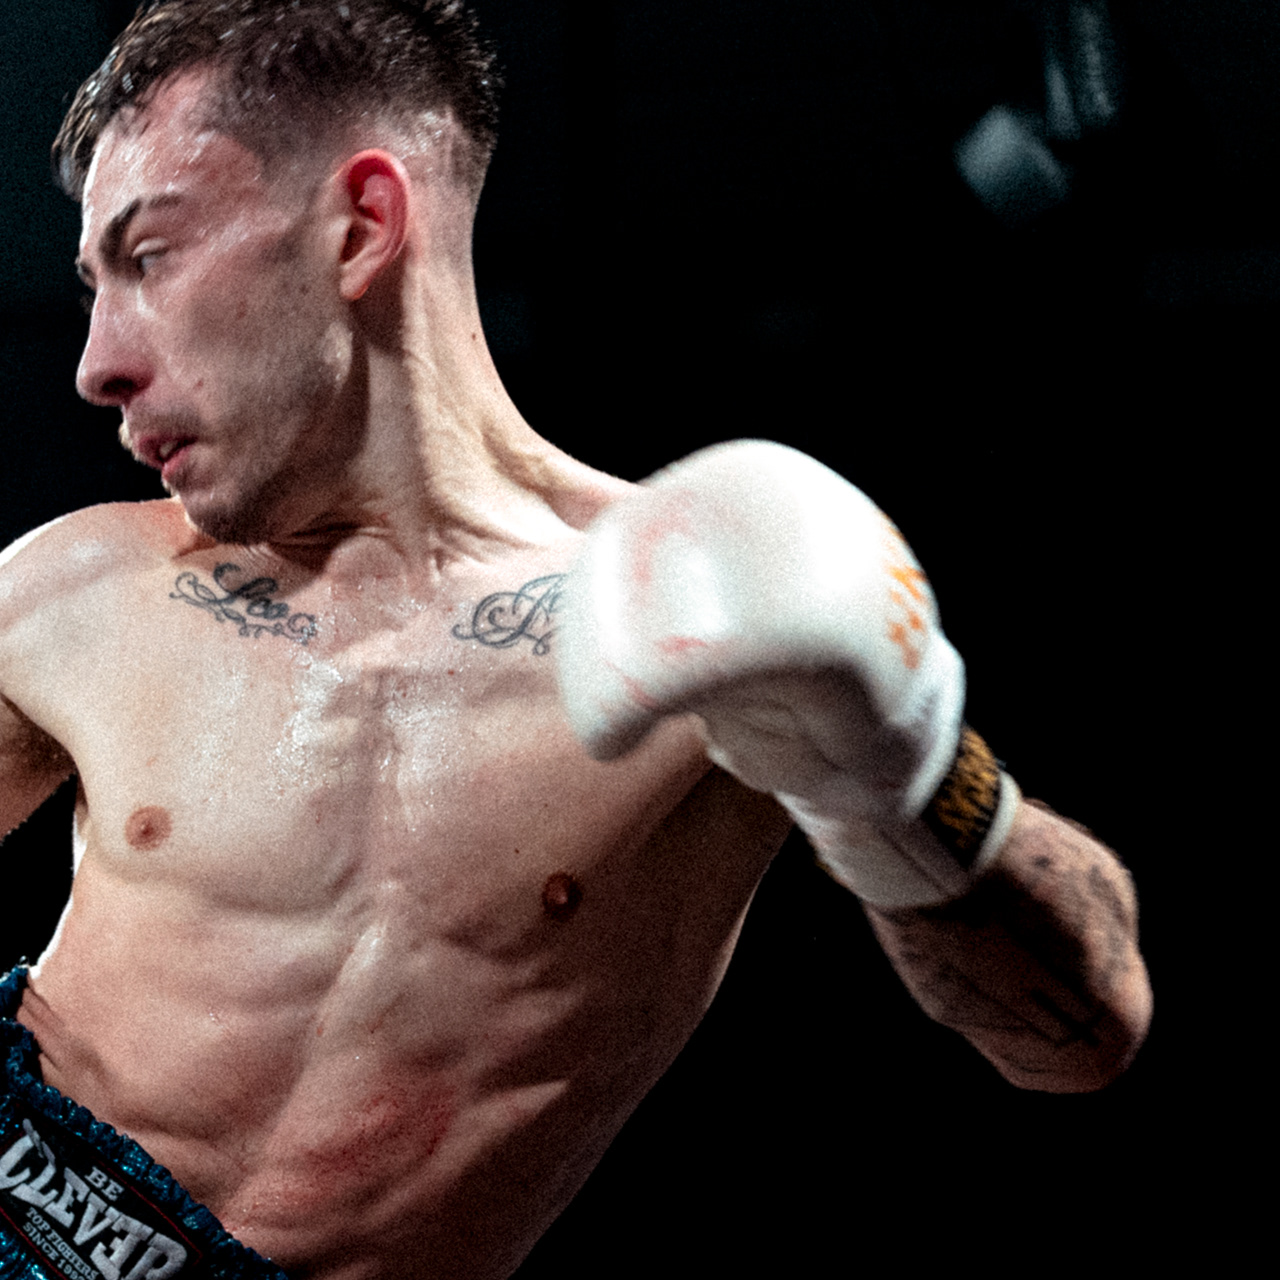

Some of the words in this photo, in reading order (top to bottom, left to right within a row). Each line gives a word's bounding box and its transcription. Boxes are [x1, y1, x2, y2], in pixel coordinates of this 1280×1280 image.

[84, 1166, 124, 1201] BE
[25, 1206, 51, 1233] TOP
[22, 1221, 59, 1261] SINCE
